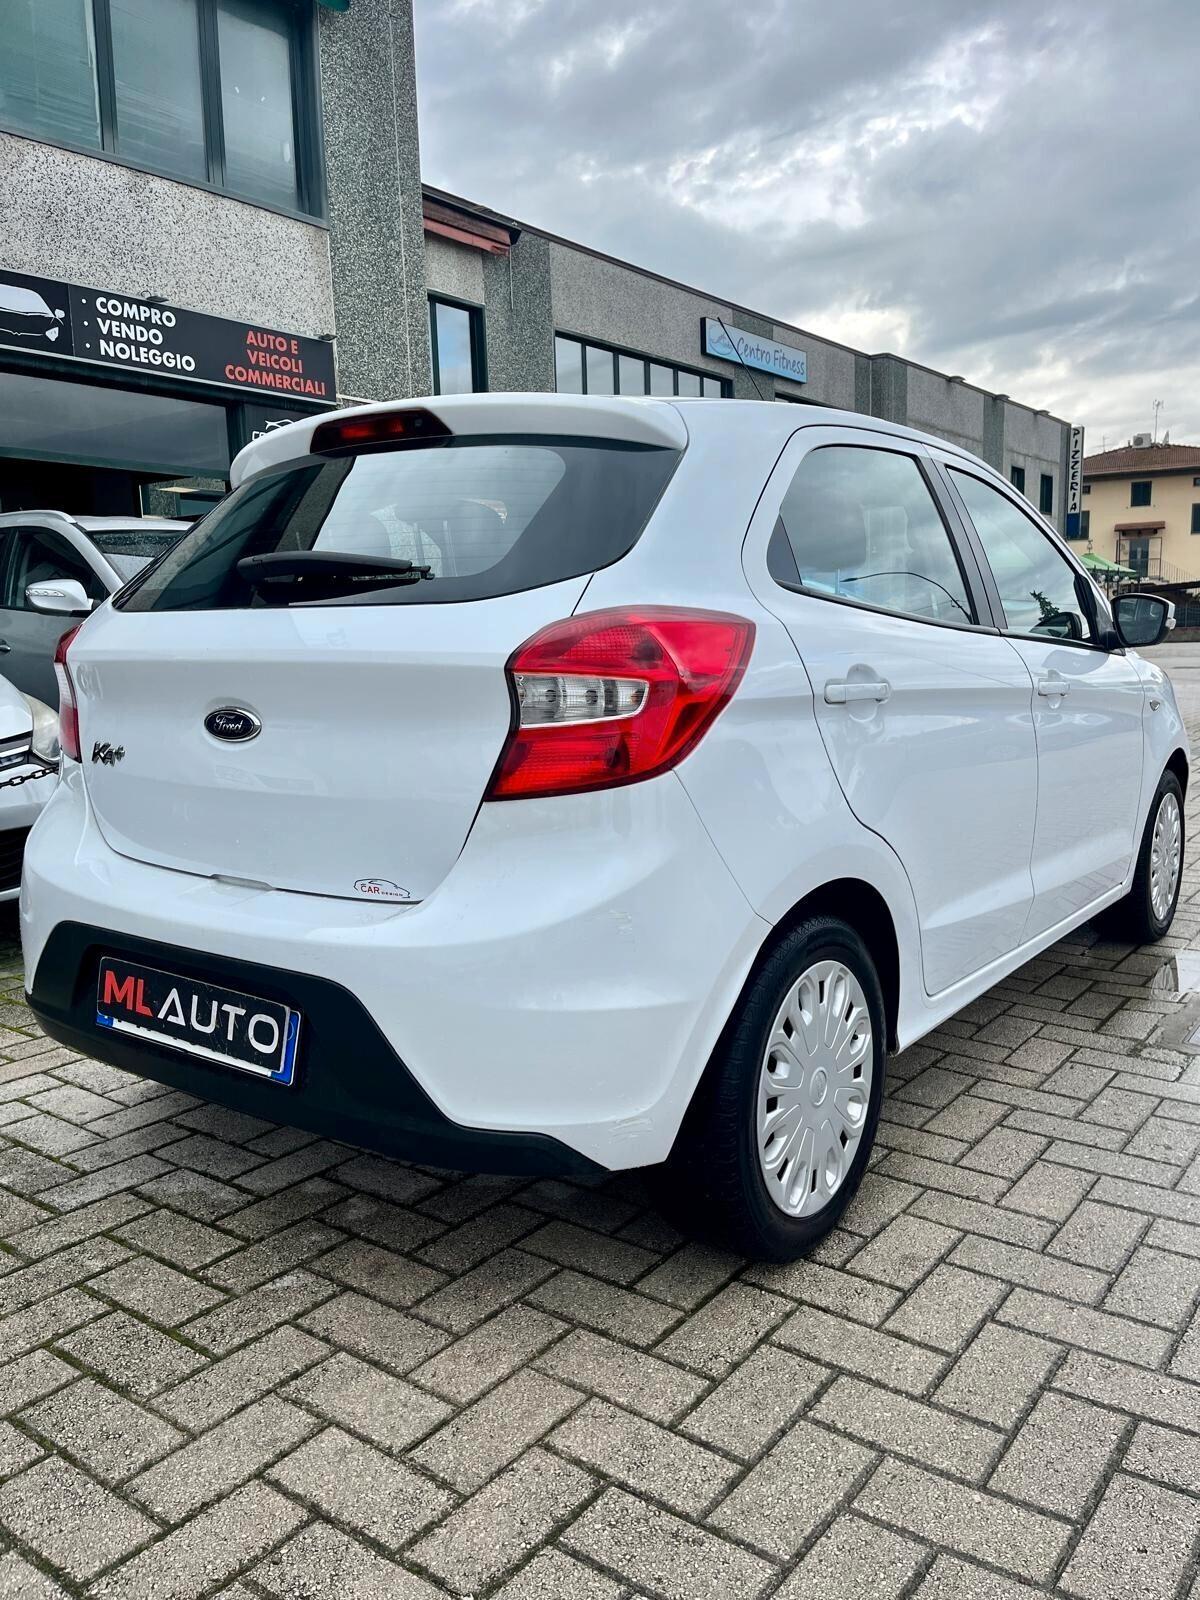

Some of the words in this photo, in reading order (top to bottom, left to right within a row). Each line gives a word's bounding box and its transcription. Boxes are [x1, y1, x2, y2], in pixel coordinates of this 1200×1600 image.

[95, 296, 176, 328] COMPRO
[97, 317, 164, 346] VENDO
[246, 330, 287, 353] AUTO
[290, 339, 298, 355] E
[99, 339, 196, 372] NOLEGGIO
[246, 349, 304, 374] VEICOLI
[736, 337, 771, 365] Centro
[773, 349, 805, 376] Fitness
[224, 364, 326, 396] COMMERCIALI
[1069, 428, 1081, 512] PIZZERIA
[214, 714, 244, 731] Ford
[360, 885, 380, 896] CAR
[103, 970, 154, 1018] ML
[157, 987, 280, 1054] AUTO
